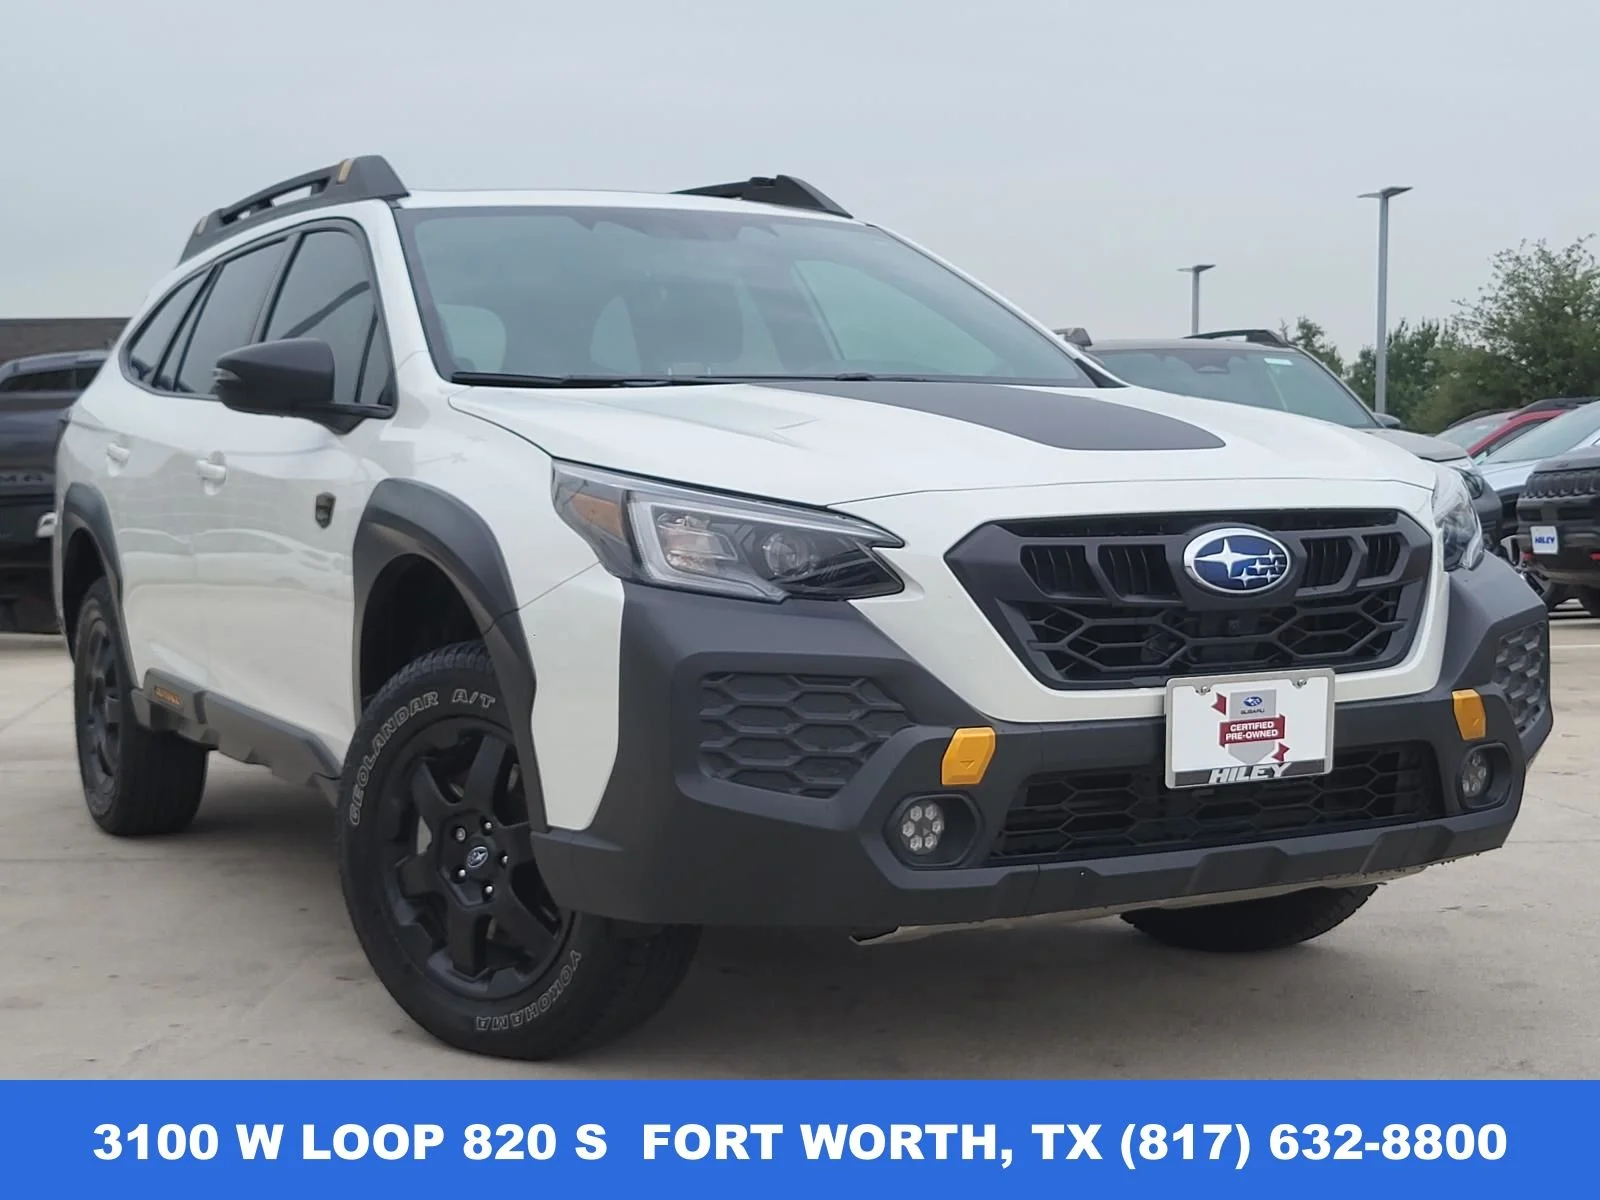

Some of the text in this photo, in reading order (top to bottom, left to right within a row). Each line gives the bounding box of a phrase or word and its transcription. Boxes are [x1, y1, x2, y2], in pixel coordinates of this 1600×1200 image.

[1225, 729, 1278, 741] PRE-OWNED
[1230, 721, 1274, 732] CERTIFIED
[350, 688, 495, 825] GEOLANDAR A/T
[1208, 762, 1292, 785] HILEY
[476, 950, 582, 1030] YOKOHAMA
